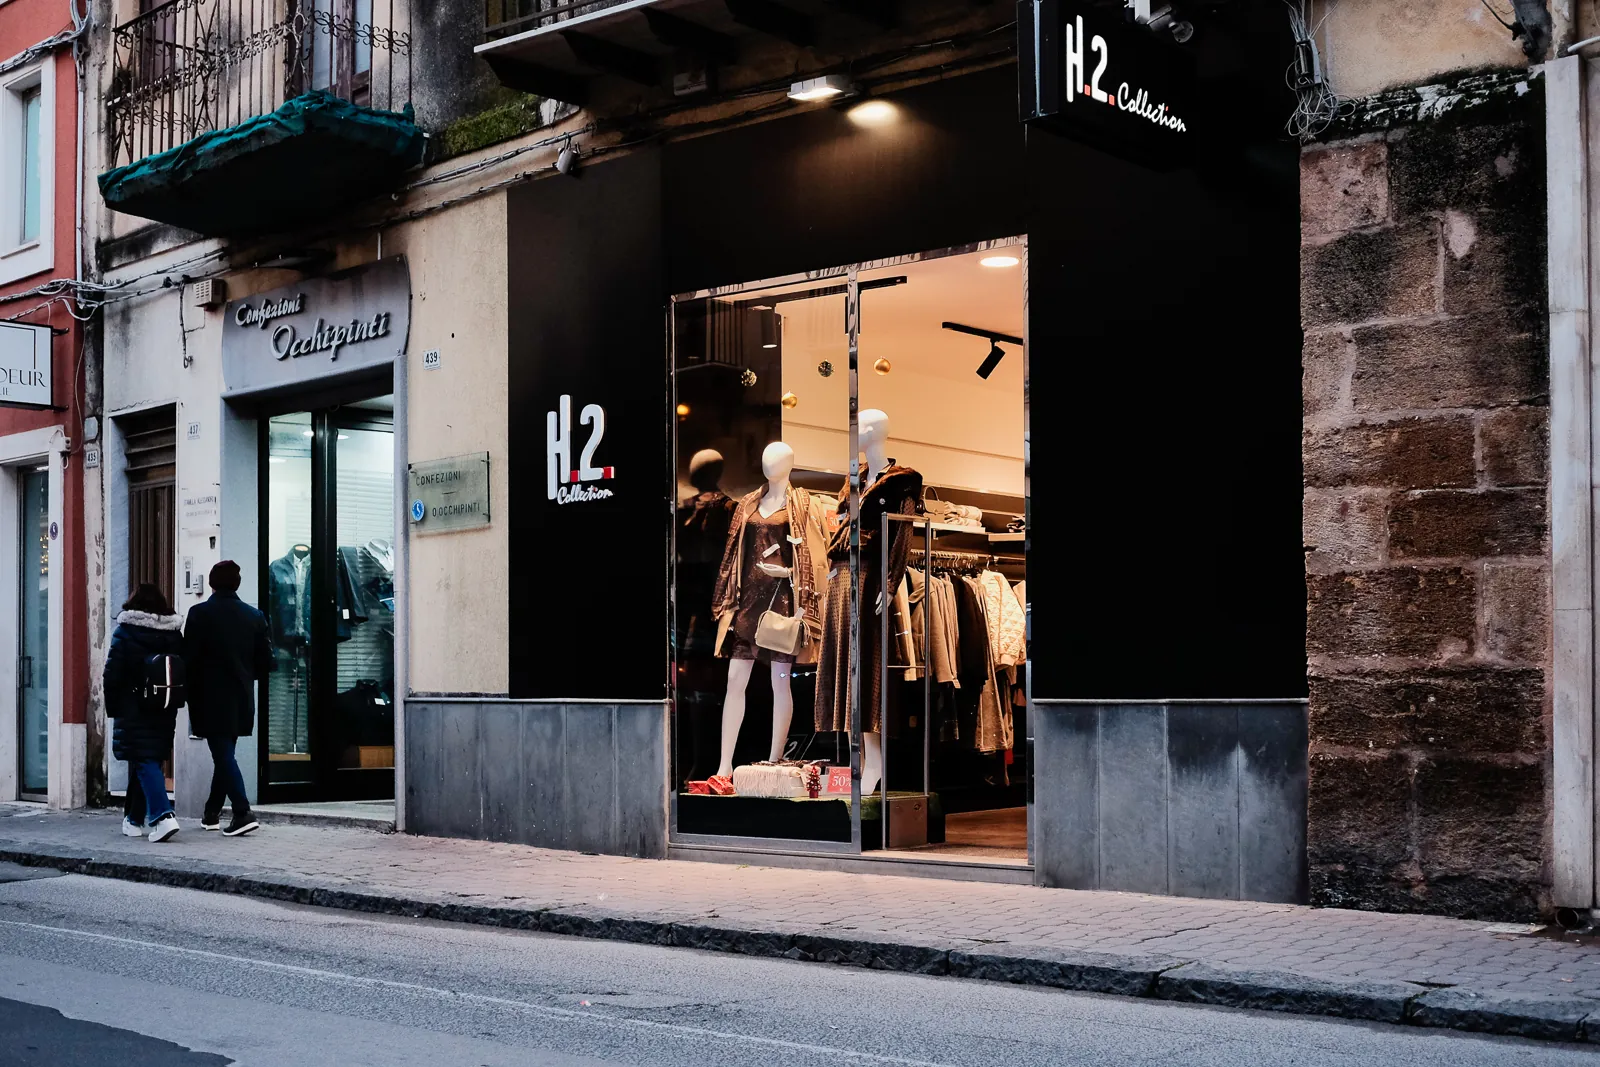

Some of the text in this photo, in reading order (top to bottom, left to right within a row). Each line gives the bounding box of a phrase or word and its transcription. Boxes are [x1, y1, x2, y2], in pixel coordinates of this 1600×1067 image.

[1117, 82, 1187, 132] Collection
[235, 294, 302, 328] Confezioni
[271, 311, 388, 361] Occhipinti
[425, 351, 438, 364] 439
[189, 424, 199, 435] 437
[87, 452, 96, 462] 435
[415, 470, 461, 486] CONFEZIONI
[557, 483, 613, 505] Collection
